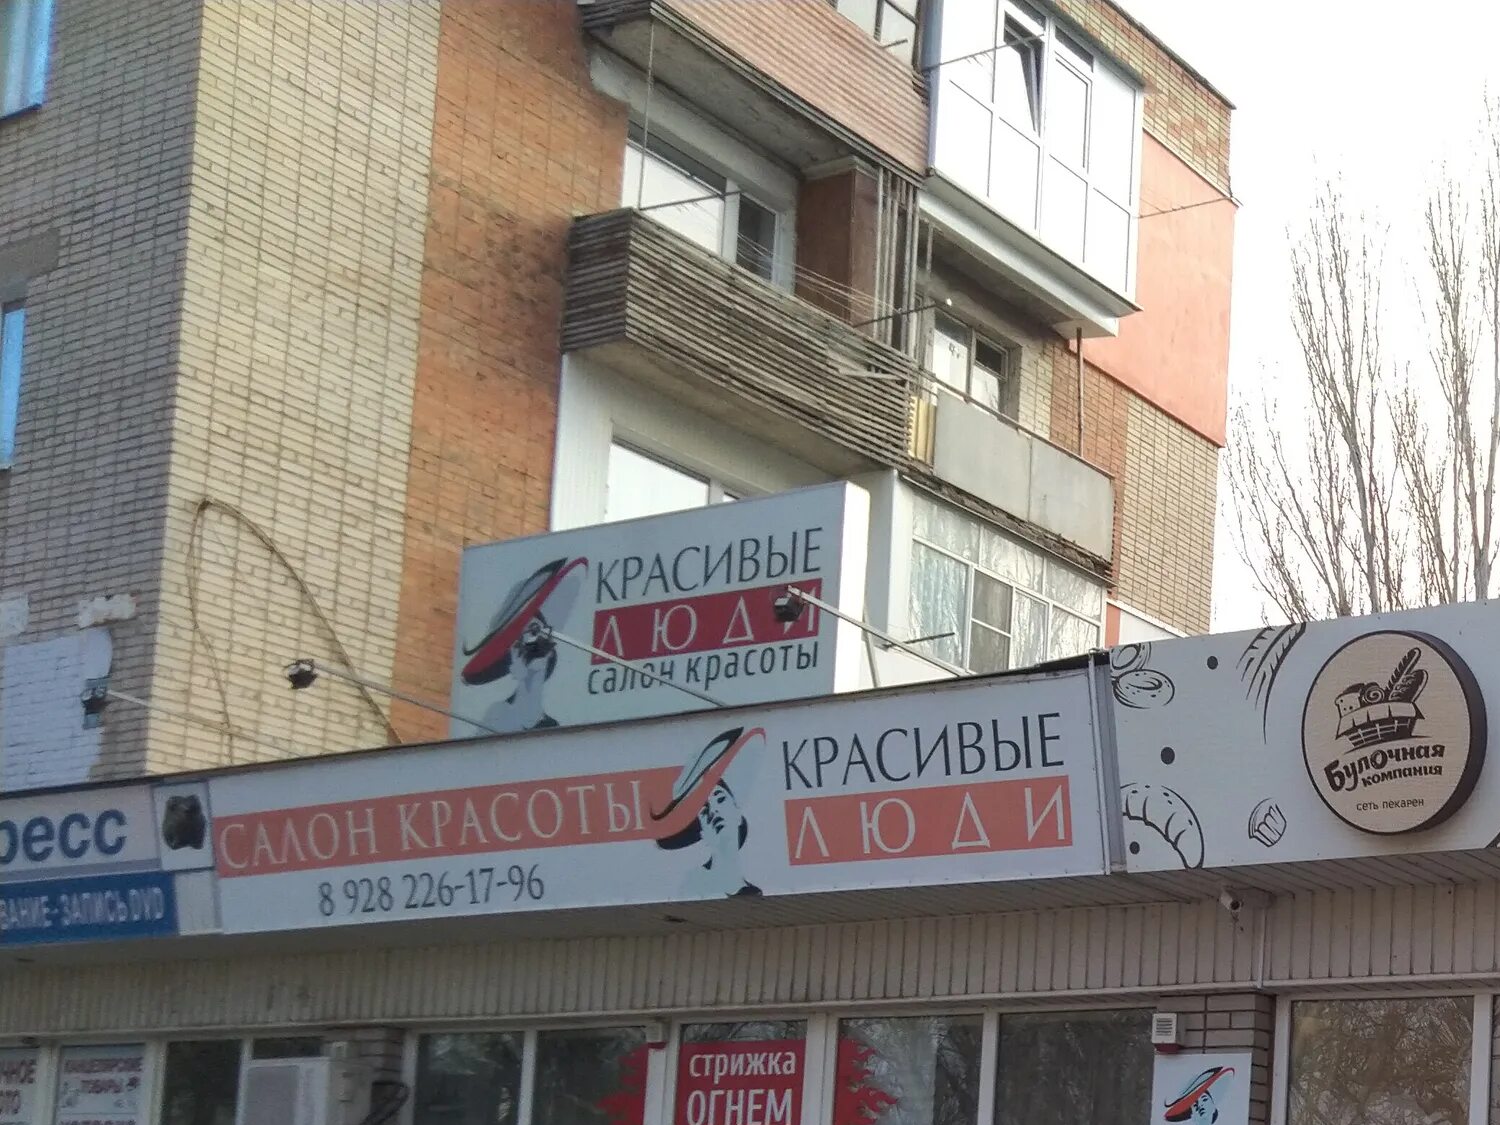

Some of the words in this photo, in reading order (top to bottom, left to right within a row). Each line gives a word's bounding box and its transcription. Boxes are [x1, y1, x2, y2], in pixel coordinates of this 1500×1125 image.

[596, 527, 823, 603] КРАСИВЫЕ
[597, 586, 816, 658] ЛЮДИ
[588, 662, 673, 694] салон
[685, 641, 819, 691] красоты
[783, 713, 1065, 790] КРАСИВЫЕ
[1323, 744, 1446, 792] Булочная
[1361, 764, 1443, 788] компания
[219, 808, 380, 869] САЛОН
[400, 781, 646, 852] КРАСОТЫ
[795, 786, 1066, 859] ЛЮДИ
[1356, 800, 1379, 811] сеть
[1382, 797, 1425, 810] пекарен
[318, 881, 335, 916] 8
[344, 876, 394, 914] 928
[403, 863, 545, 910] 226-17-96
[689, 1051, 796, 1084] стрижка
